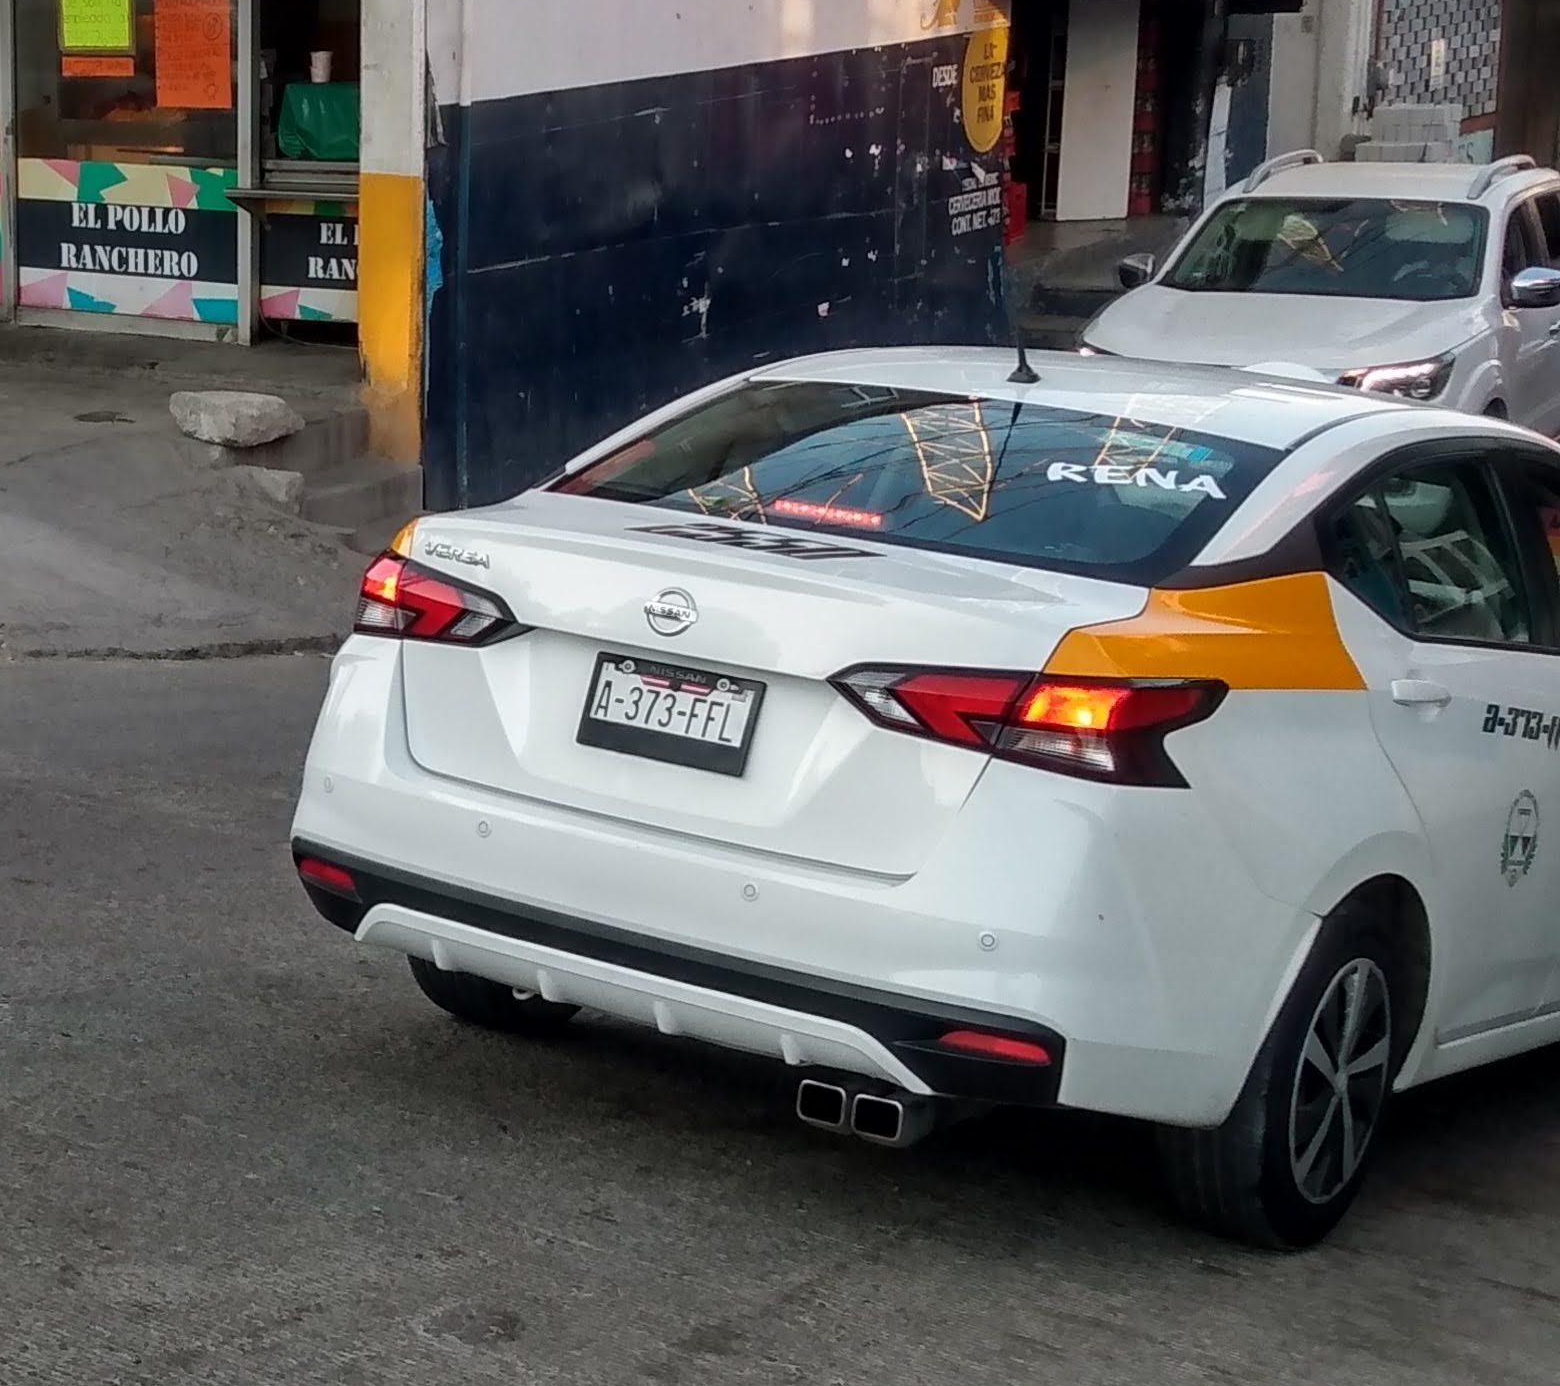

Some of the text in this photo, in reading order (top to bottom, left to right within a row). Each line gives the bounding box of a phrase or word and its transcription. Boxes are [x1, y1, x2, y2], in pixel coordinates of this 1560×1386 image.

[932, 63, 958, 88] DESDE
[71, 202, 186, 235] EL POLLO
[319, 222, 349, 246] EL
[59, 242, 199, 278] RANCHERO
[307, 255, 359, 282] RAN
[1046, 462, 1227, 500] RENA
[424, 540, 491, 570] VERSA
[644, 604, 691, 619] NISSAN
[648, 663, 708, 685] NISSAN
[593, 678, 733, 745] A-373-FFL
